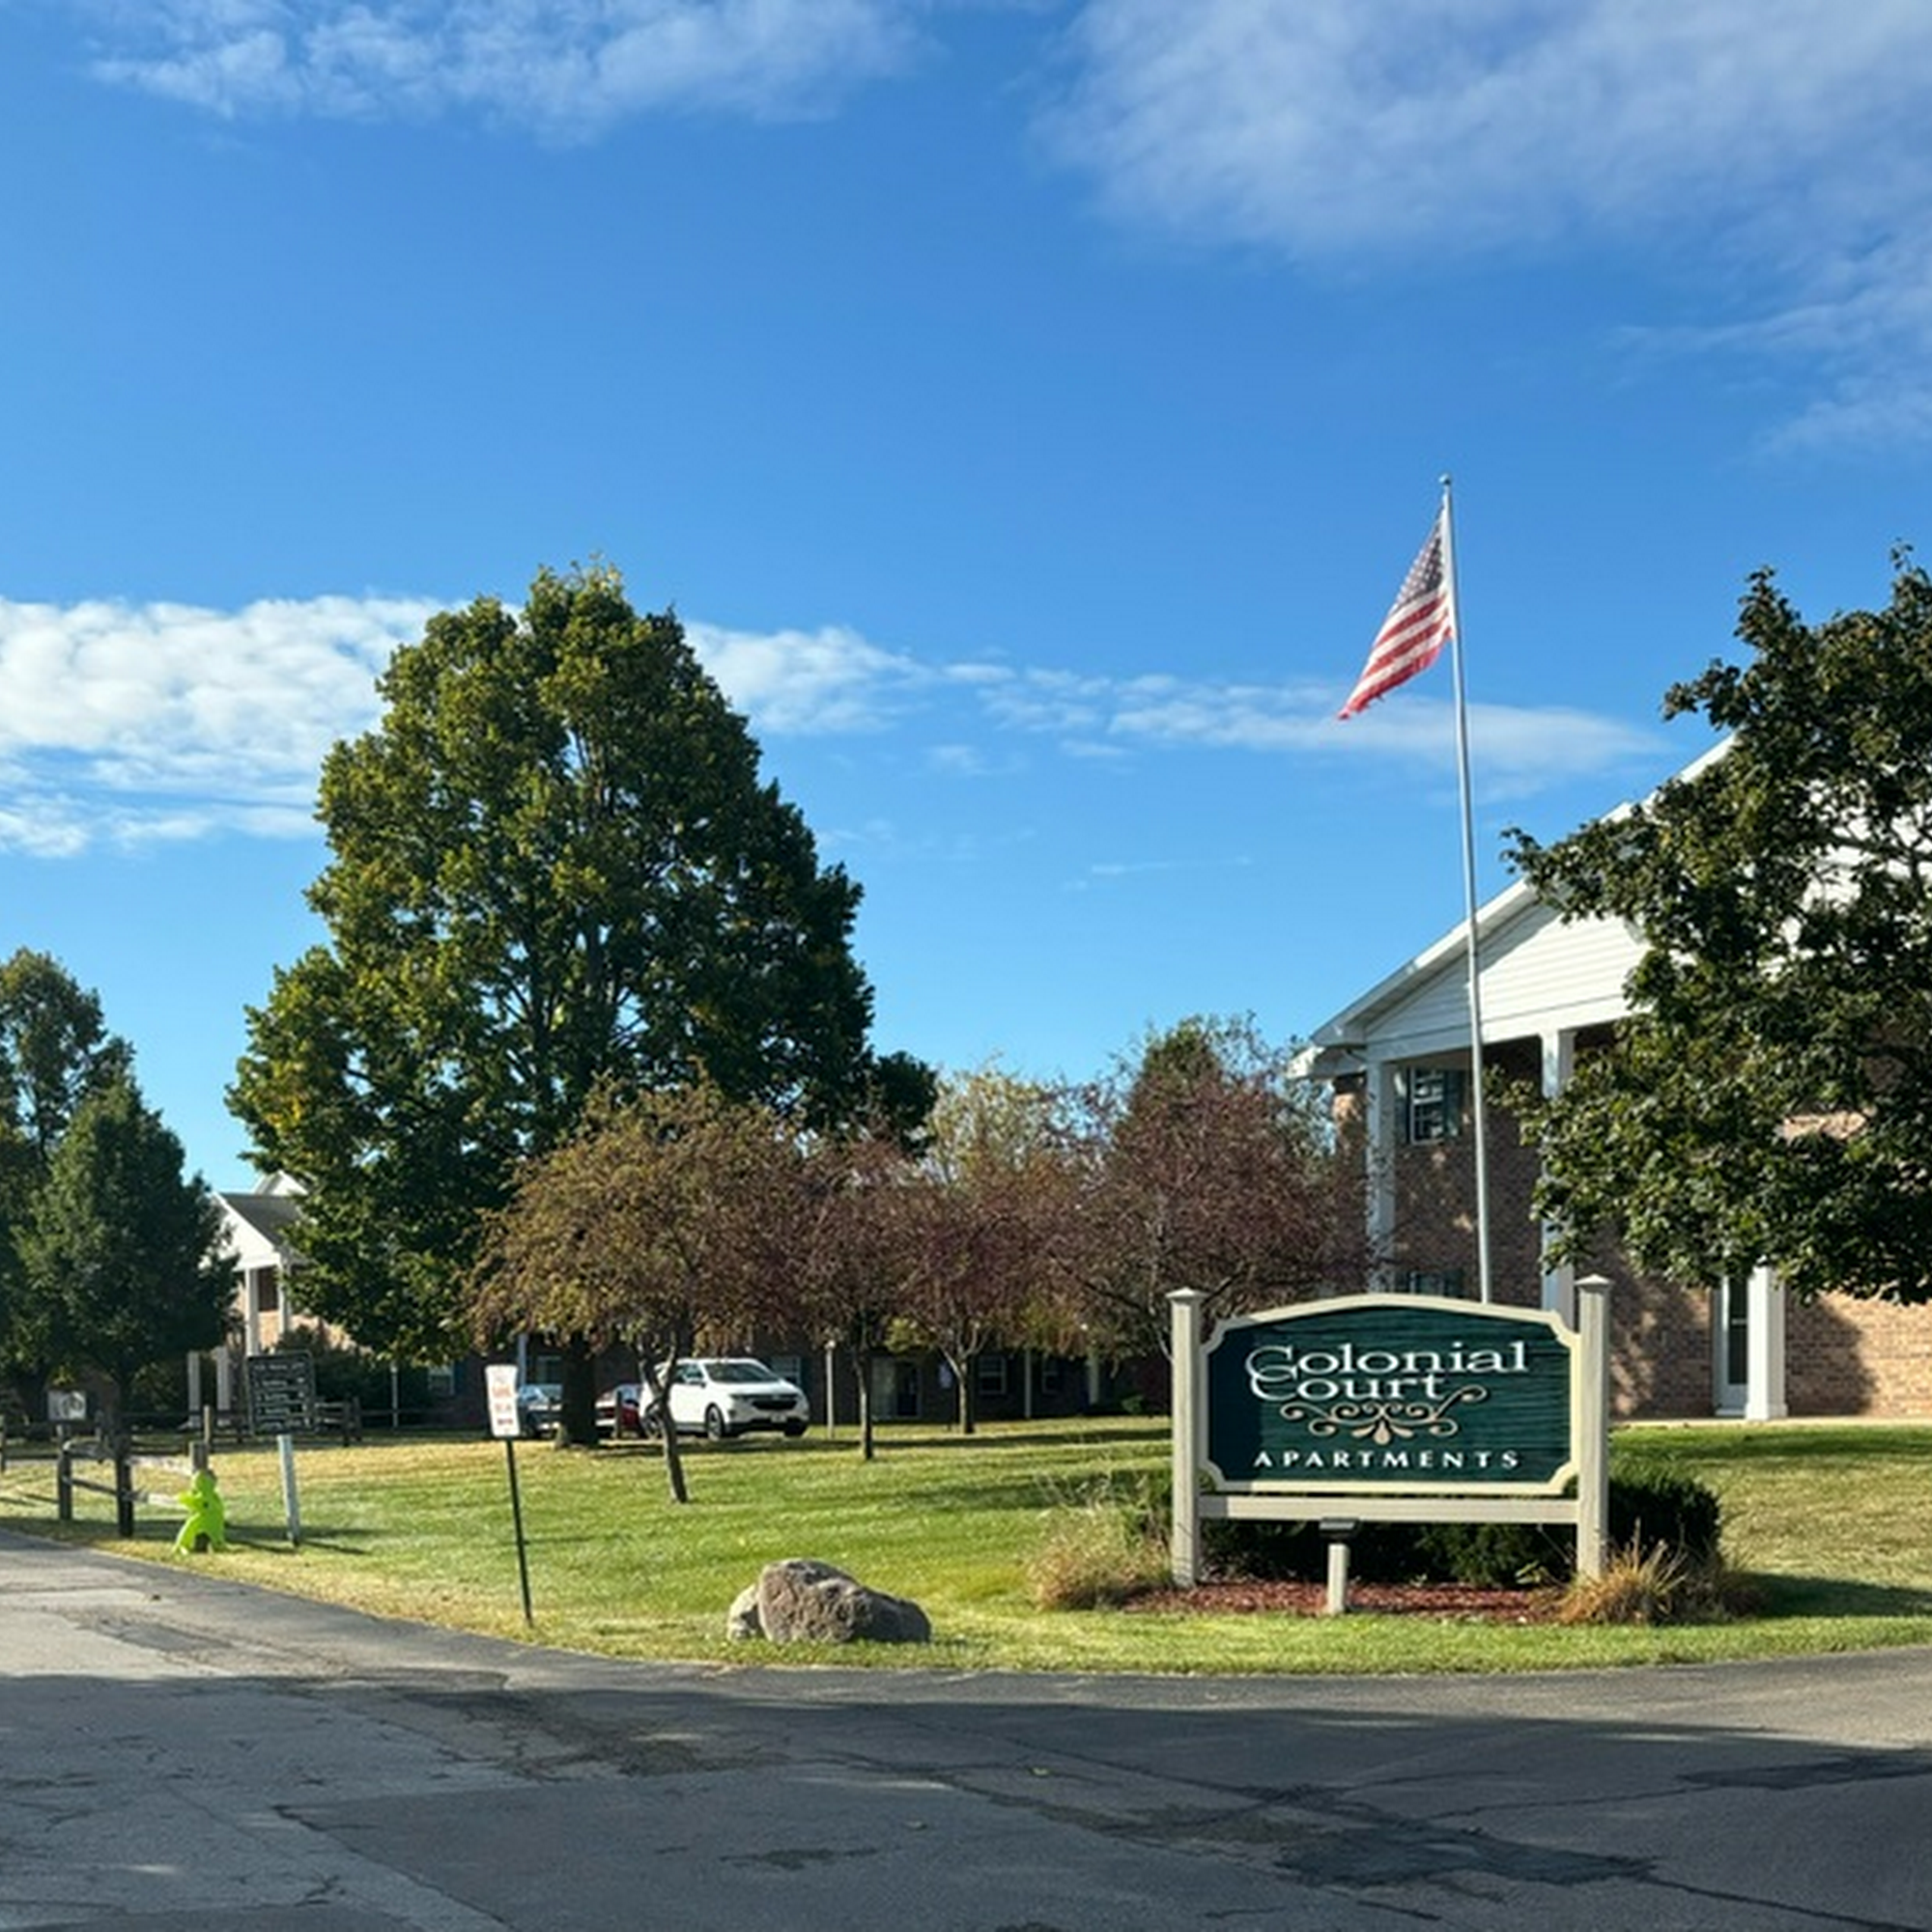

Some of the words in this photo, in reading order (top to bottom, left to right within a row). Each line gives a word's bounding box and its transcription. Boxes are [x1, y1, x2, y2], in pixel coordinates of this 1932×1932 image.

[1245, 1341, 1528, 1381] Colonial
[1250, 1365, 1447, 1401] Court
[1254, 1450, 1520, 1469] APARTMENTS
